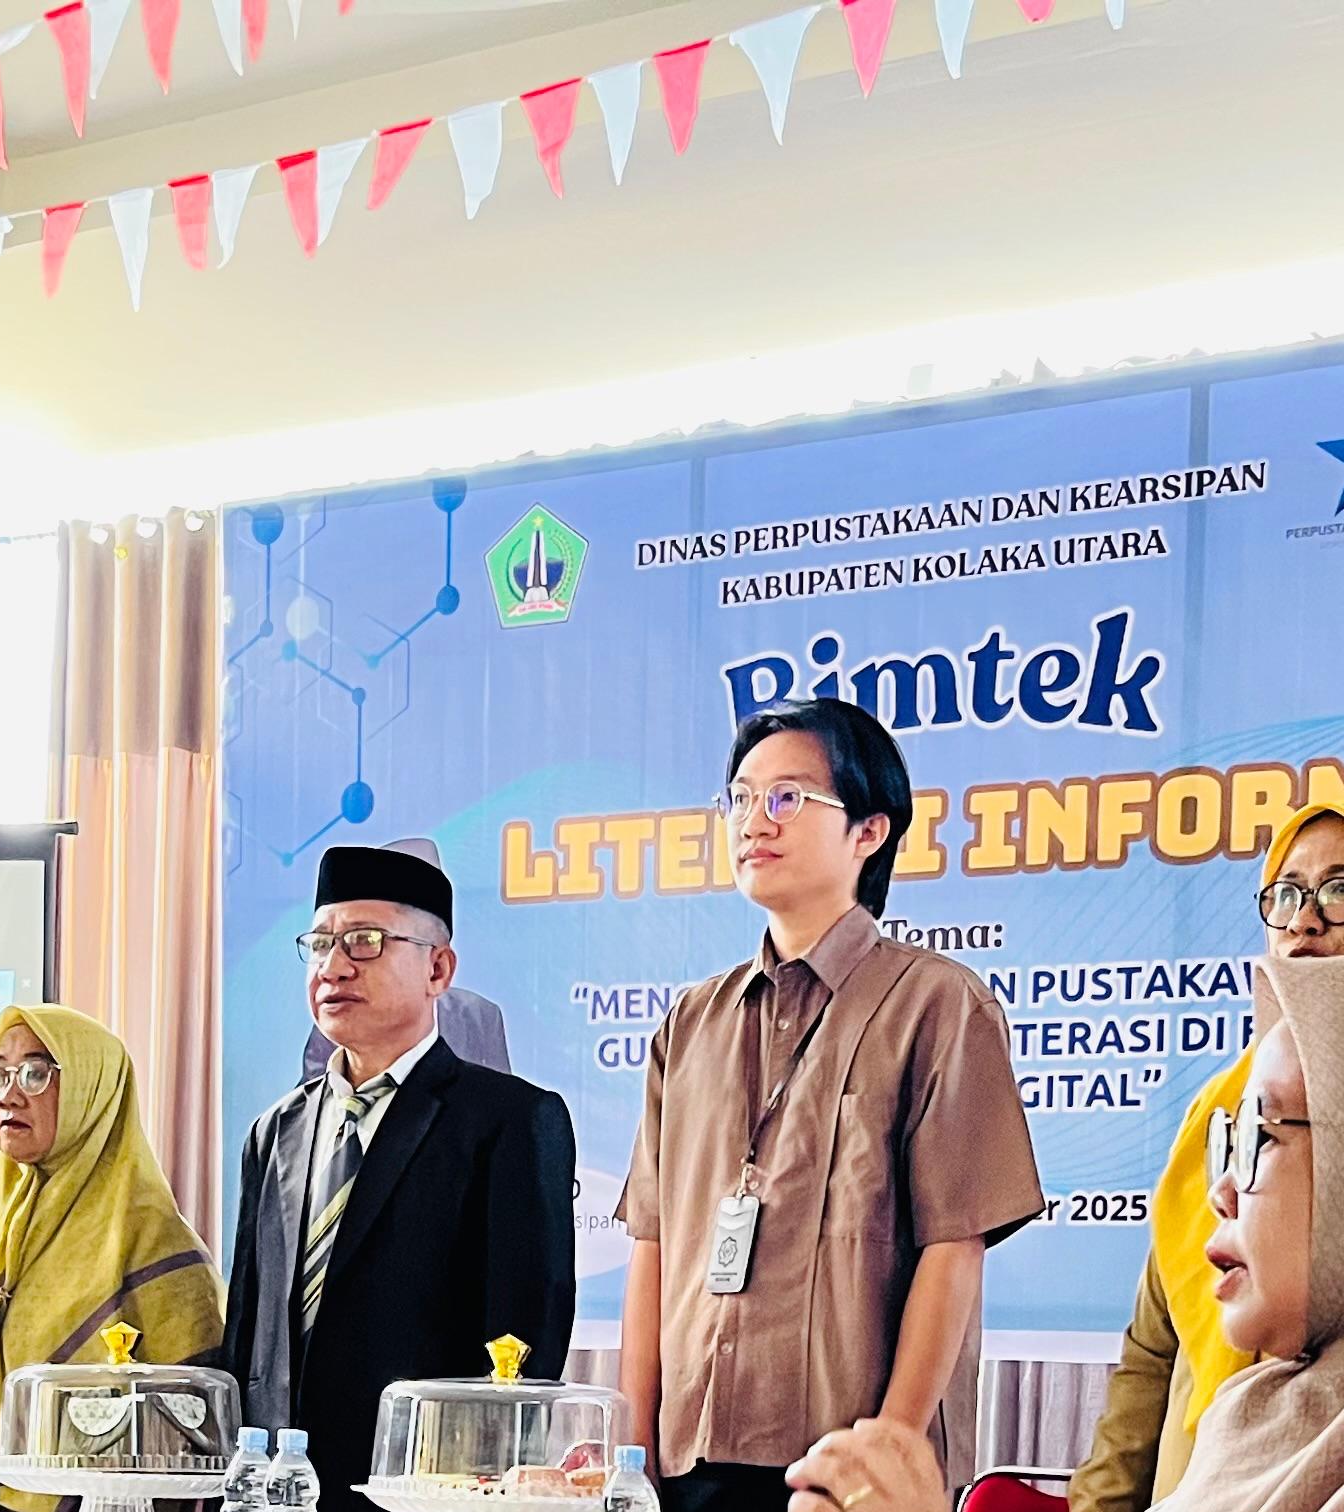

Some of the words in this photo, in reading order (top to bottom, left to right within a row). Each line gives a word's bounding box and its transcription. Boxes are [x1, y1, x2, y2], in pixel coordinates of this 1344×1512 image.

[637, 533, 727, 566] DINAS
[734, 499, 983, 554] PERPUSTAKAAN
[992, 489, 1061, 522] DAN
[1069, 462, 1267, 512] KEARSIPAN
[721, 560, 904, 605] KABUPATEN
[912, 541, 1045, 582] KOLAKA
[1054, 529, 1167, 566] UTARA
[882, 919, 1003, 950] Tema:
[1031, 961, 1251, 1003] PUSTAKA
[1012, 1018, 1165, 1056] TERASI
[1181, 1016, 1225, 1051] DI
[1017, 1068, 1162, 1109] GITAL”
[1070, 1194, 1148, 1221] 2025
